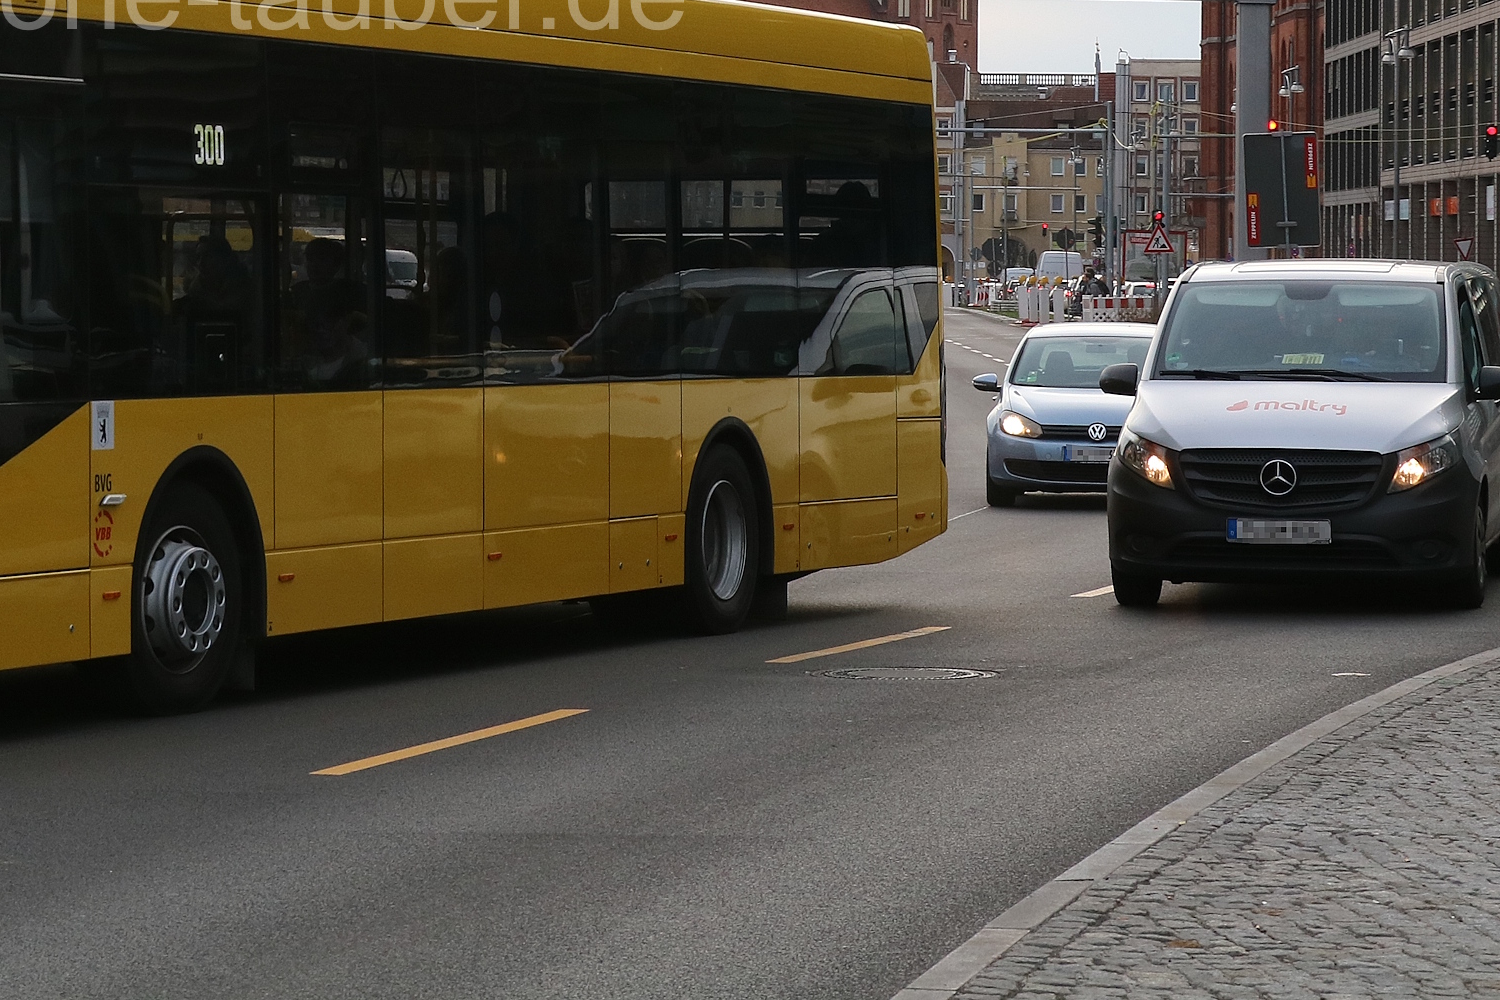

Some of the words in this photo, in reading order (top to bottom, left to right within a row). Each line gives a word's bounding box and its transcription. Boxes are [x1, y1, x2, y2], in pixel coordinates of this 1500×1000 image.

[194, 124, 224, 166] 300
[1253, 399, 1348, 416] maltry
[94, 473, 112, 493] BVG
[95, 526, 112, 541] VBB
